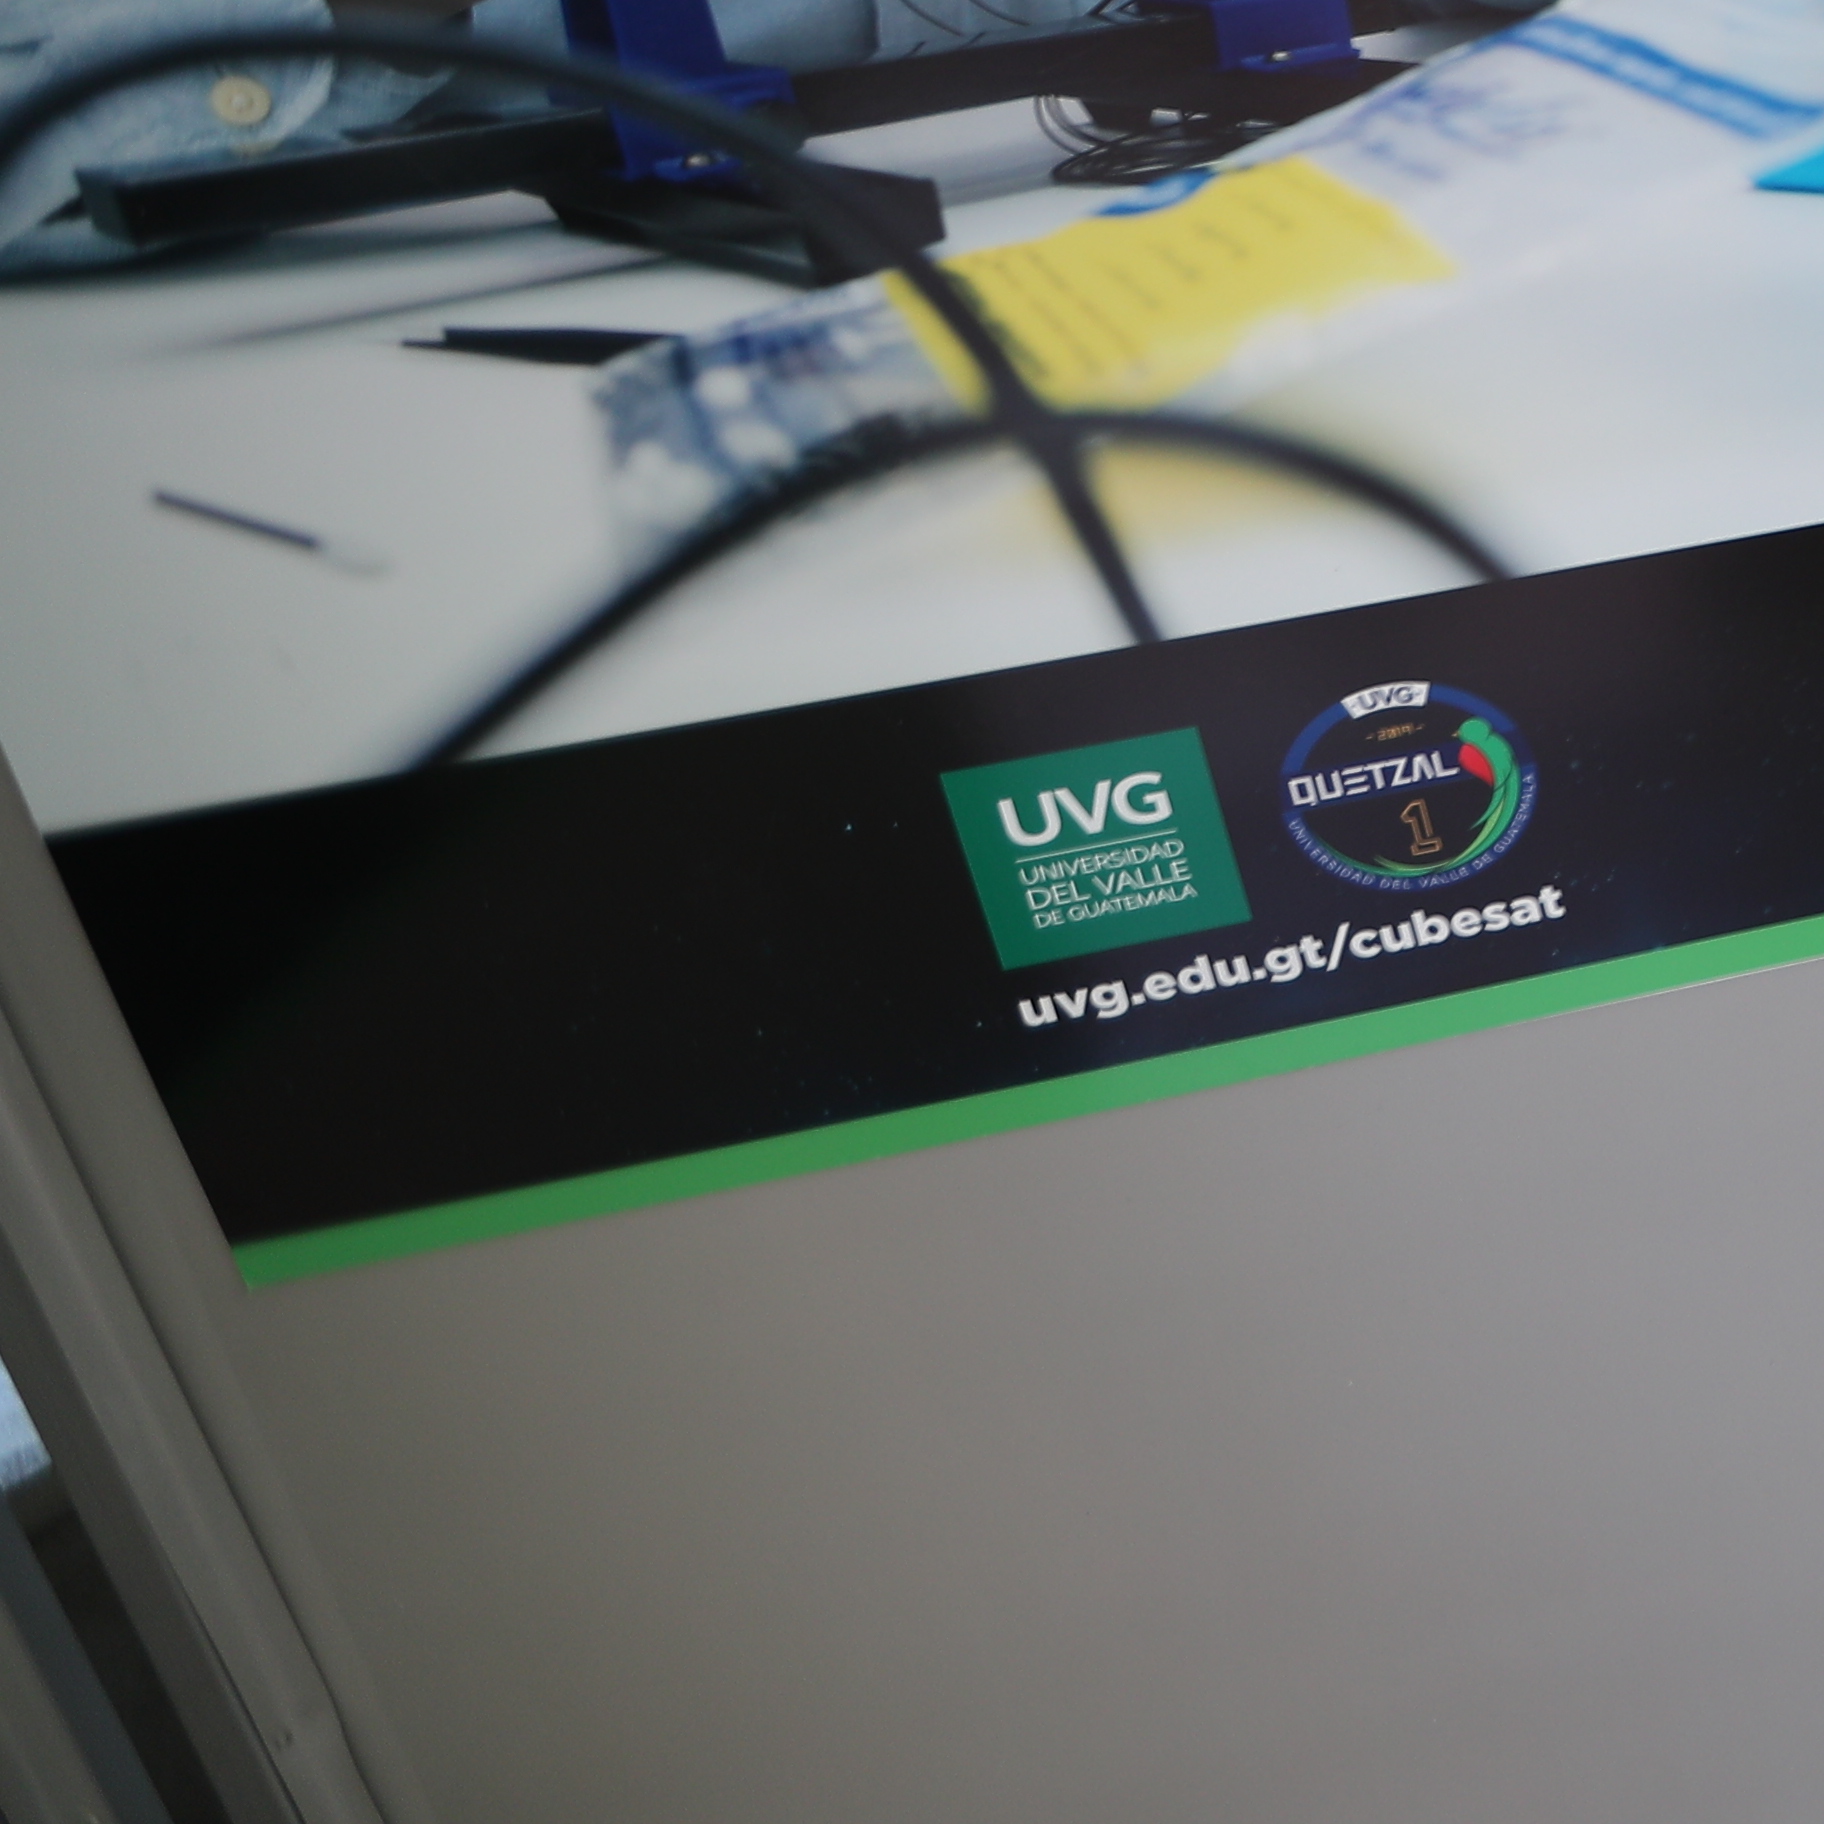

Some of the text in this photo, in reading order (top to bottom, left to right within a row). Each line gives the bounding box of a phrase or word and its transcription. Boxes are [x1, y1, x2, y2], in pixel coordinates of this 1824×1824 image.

[1356, 685, 1415, 711] UVG
[1287, 750, 1460, 807] QUETZAL
[997, 771, 1174, 847] UVG
[1288, 772, 1535, 890] UNIVERSIDAD DEL VALLE DE GUATEMALA
[1400, 797, 1443, 856] 1
[1018, 838, 1185, 886] UNIVERSIDAD
[1025, 858, 1193, 911] DEL VALLE
[1033, 882, 1199, 930] DE GUATEMALA
[1017, 884, 1567, 1028] uvg.edu.gt/cubesat
